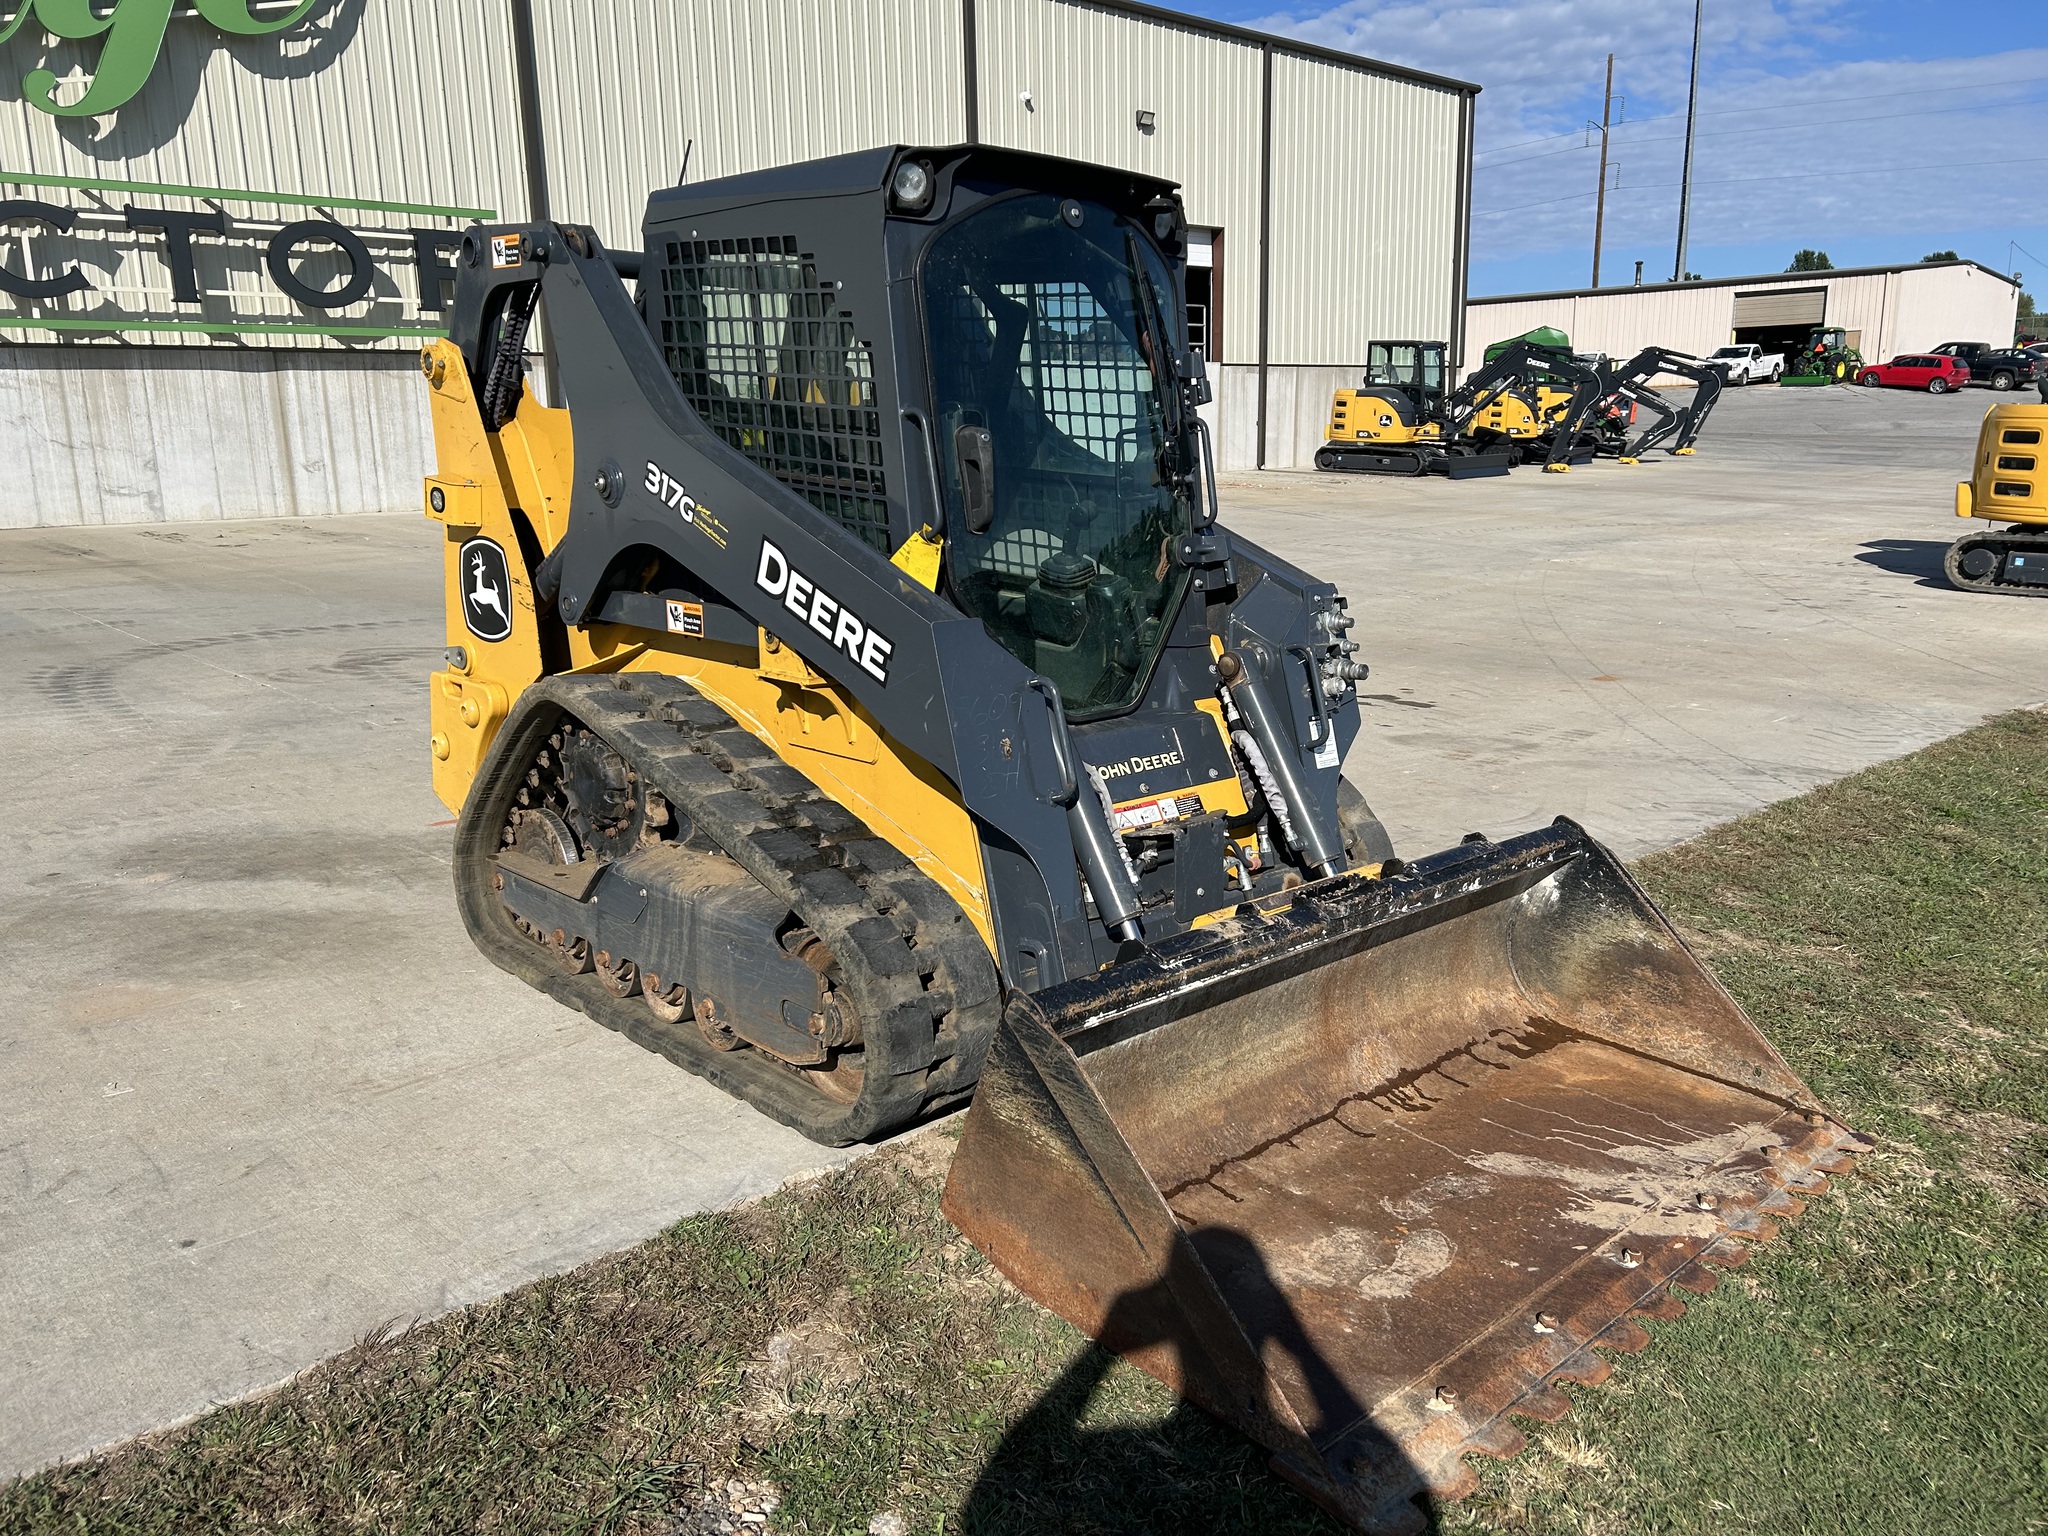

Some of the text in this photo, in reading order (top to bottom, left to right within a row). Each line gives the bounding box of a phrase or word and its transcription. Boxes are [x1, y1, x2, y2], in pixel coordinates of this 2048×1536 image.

[1526, 357, 1551, 370] DEERE
[1657, 360, 1679, 371] DEERE
[1618, 386, 1638, 400] DEERE
[644, 461, 696, 523] 317G
[756, 539, 893, 683] DEERE
[1092, 751, 1181, 780] OHN DEERE
